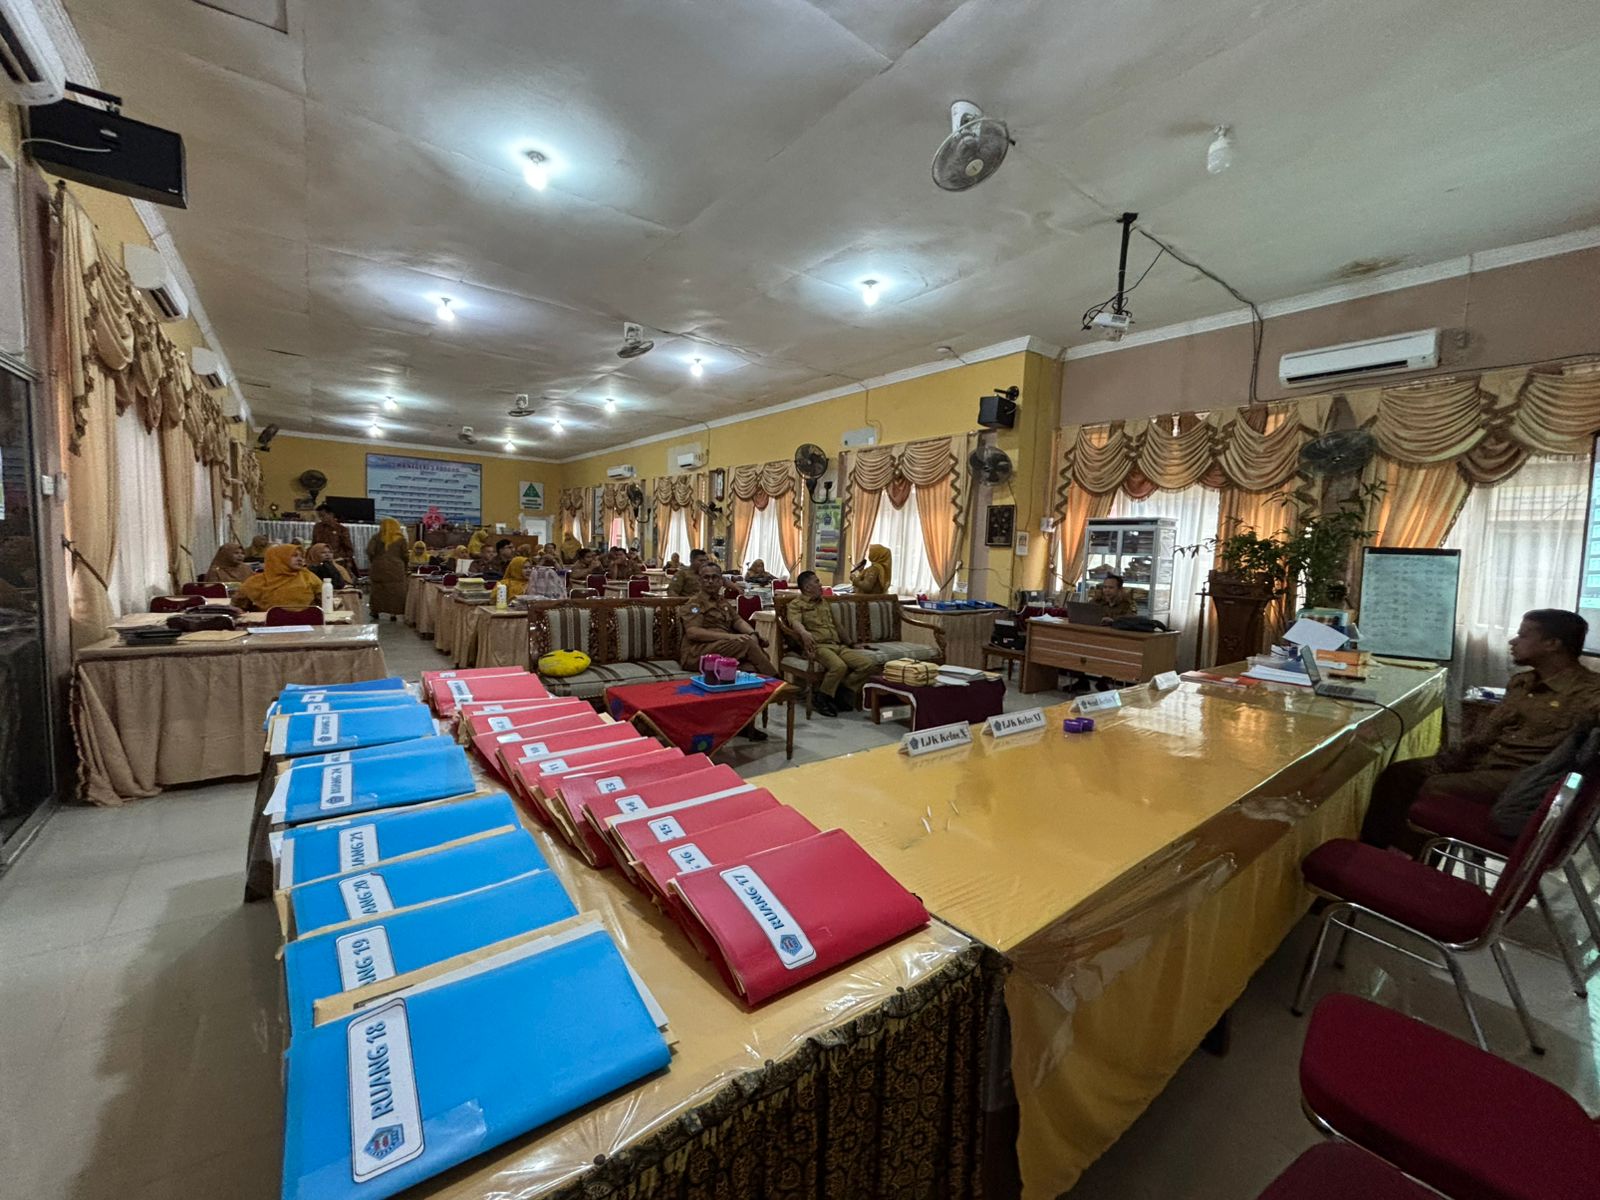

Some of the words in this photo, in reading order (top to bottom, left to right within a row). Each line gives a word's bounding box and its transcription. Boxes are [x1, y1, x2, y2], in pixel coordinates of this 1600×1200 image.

[1002, 718, 1017, 730] LJK
[920, 734, 940, 748] LJK
[939, 731, 960, 744] Kelas
[625, 801, 639, 812] 14
[349, 831, 364, 842] 21
[658, 823, 673, 836] 15
[350, 842, 366, 867] ANG
[679, 851, 696, 864] 16
[352, 879, 371, 893] 20
[732, 874, 749, 886] 17
[357, 892, 379, 915] ANG
[744, 886, 785, 930] RUANG
[351, 938, 371, 956] 19
[365, 1020, 387, 1044] 18
[366, 1042, 394, 1121] RUANG
